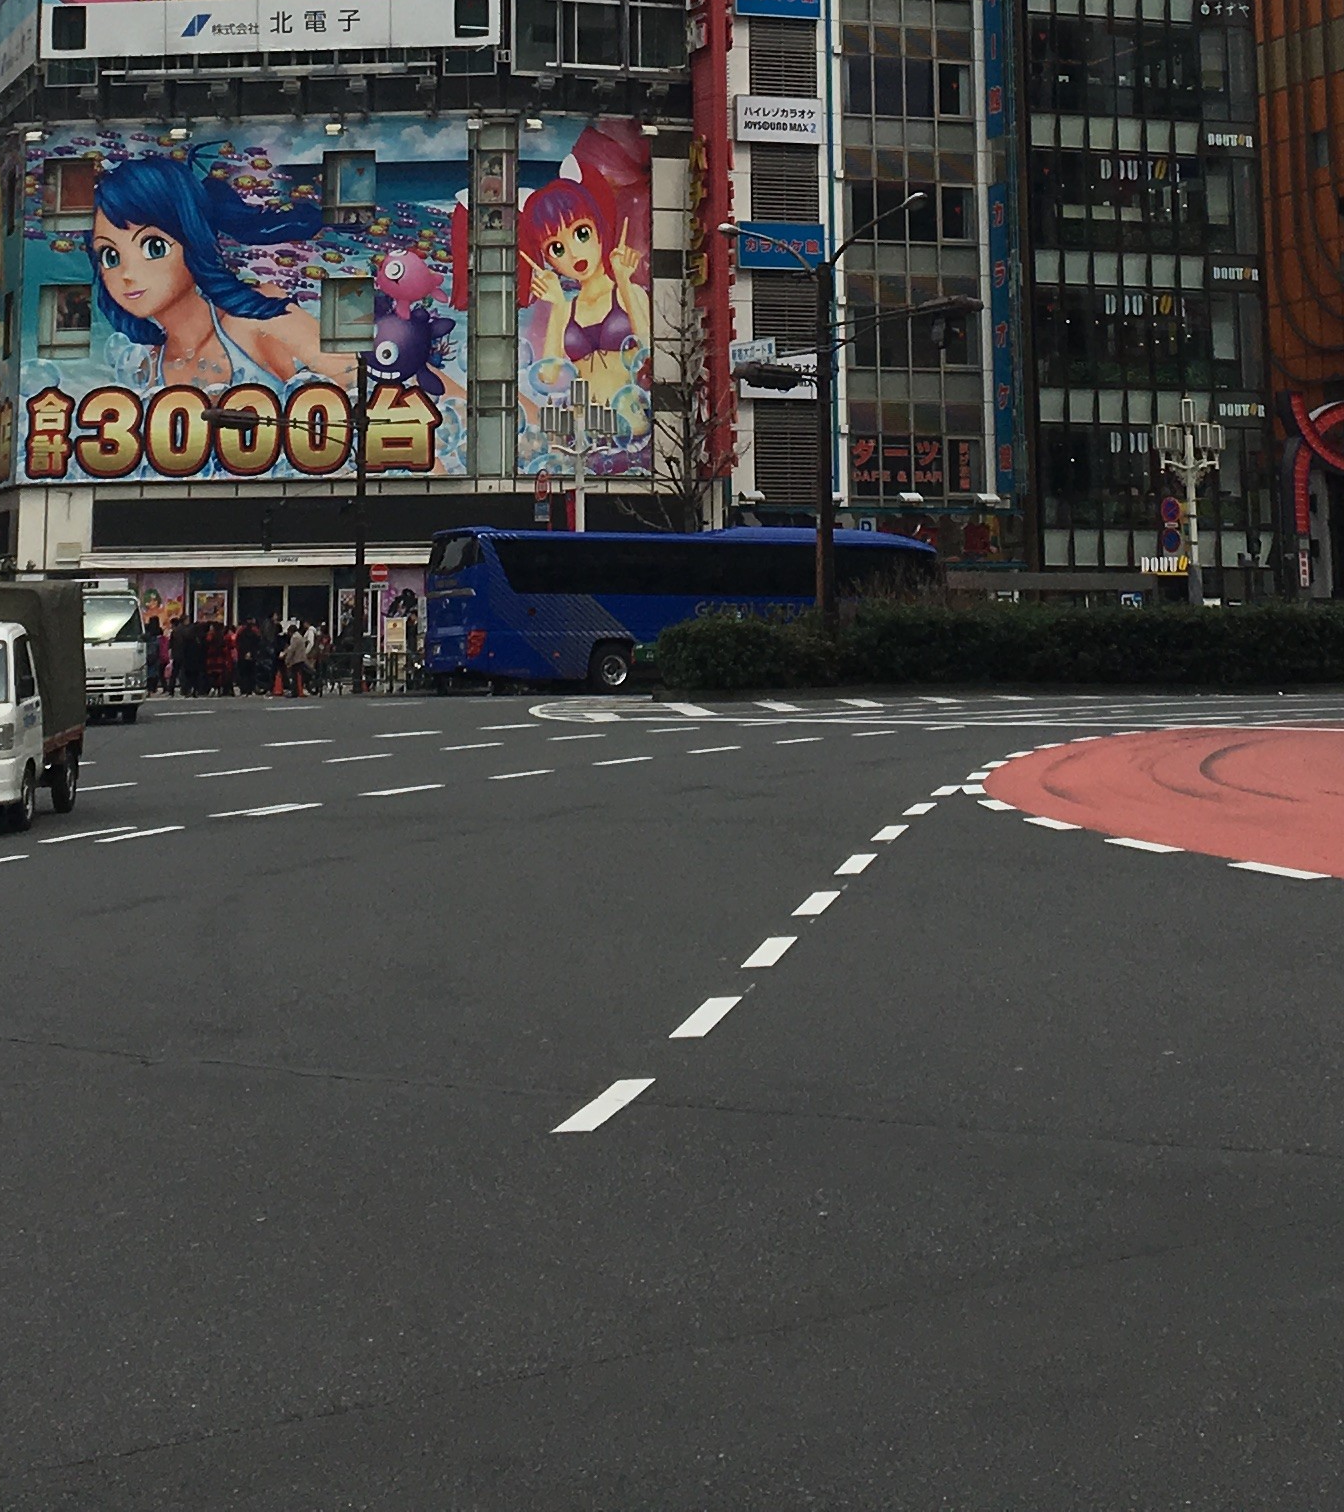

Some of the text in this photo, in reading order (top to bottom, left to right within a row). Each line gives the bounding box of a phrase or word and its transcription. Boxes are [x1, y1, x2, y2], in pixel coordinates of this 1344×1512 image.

[211, 8, 361, 37] 株式会社 北電子
[743, 105, 816, 121] ハイレゾカラオケ
[743, 120, 787, 134] JOYSOUND
[1207, 132, 1253, 148] DOUTOR
[1213, 266, 1260, 282] DOUTOR
[1219, 402, 1265, 418] DOUTOR
[26, 383, 444, 479] 合計 3000台
[851, 438, 941, 467] ダーツ
